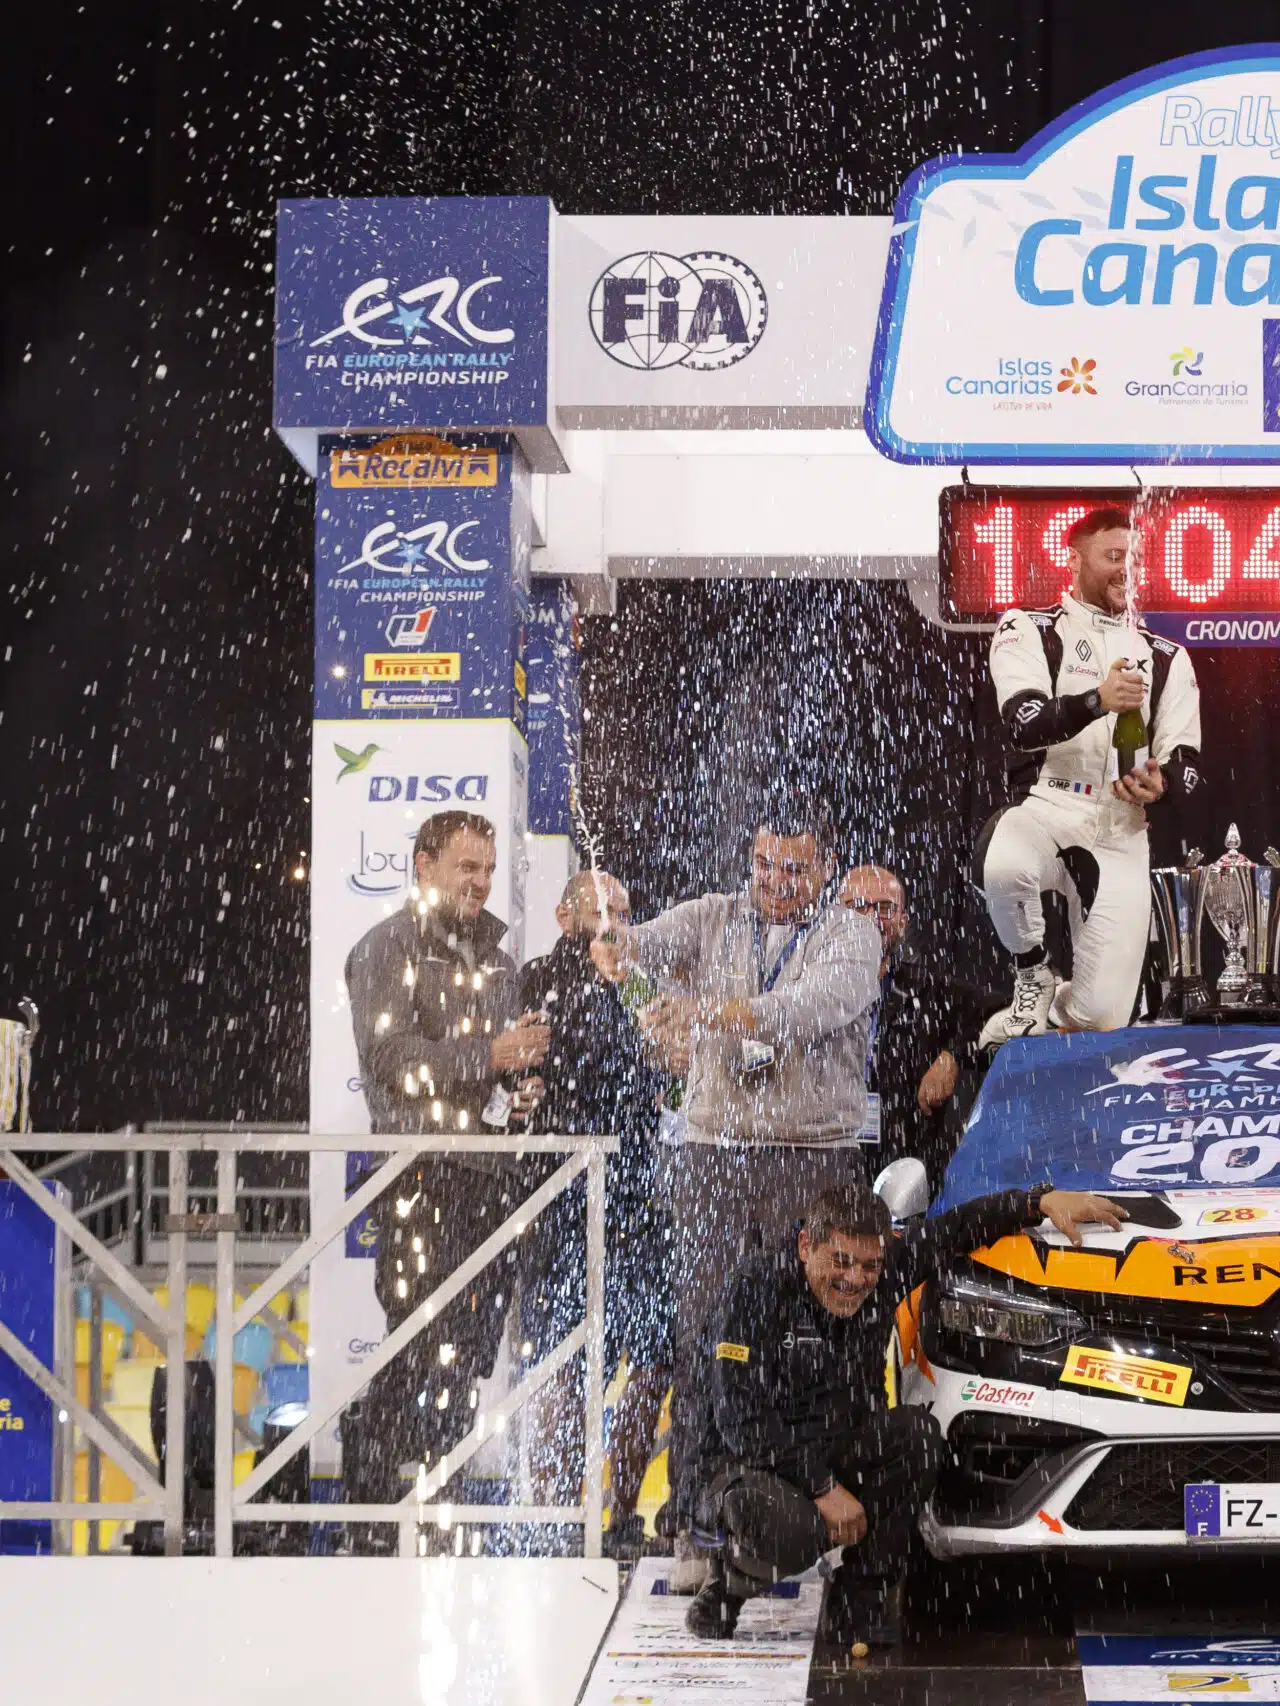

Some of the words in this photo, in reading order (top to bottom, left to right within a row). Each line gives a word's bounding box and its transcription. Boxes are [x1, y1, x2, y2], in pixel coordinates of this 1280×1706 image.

[305, 355, 338, 369] FIA
[343, 354, 449, 368] EUROPEAN
[453, 352, 512, 367] RALLY
[999, 358, 1052, 376] Islas
[341, 370, 509, 386] CHAMPIONSHIP
[946, 376, 1052, 395] Canarias
[363, 454, 464, 479] Recalvi
[335, 579, 358, 589] FIA
[363, 578, 442, 588] EUROPEAN
[443, 577, 487, 587] RALLY
[360, 591, 485, 602] CHAMPIONSHIP
[375, 659, 451, 675] PIRELLI
[389, 694, 453, 703] MICHELIN
[1048, 780, 1071, 790] OMP
[1104, 1092, 1156, 1107] FIA
[1211, 1208, 1255, 1223] 28
[1074, 1354, 1177, 1394] PIRELLI
[976, 1383, 1034, 1406] Castrol
[1197, 1522, 1208, 1536] F
